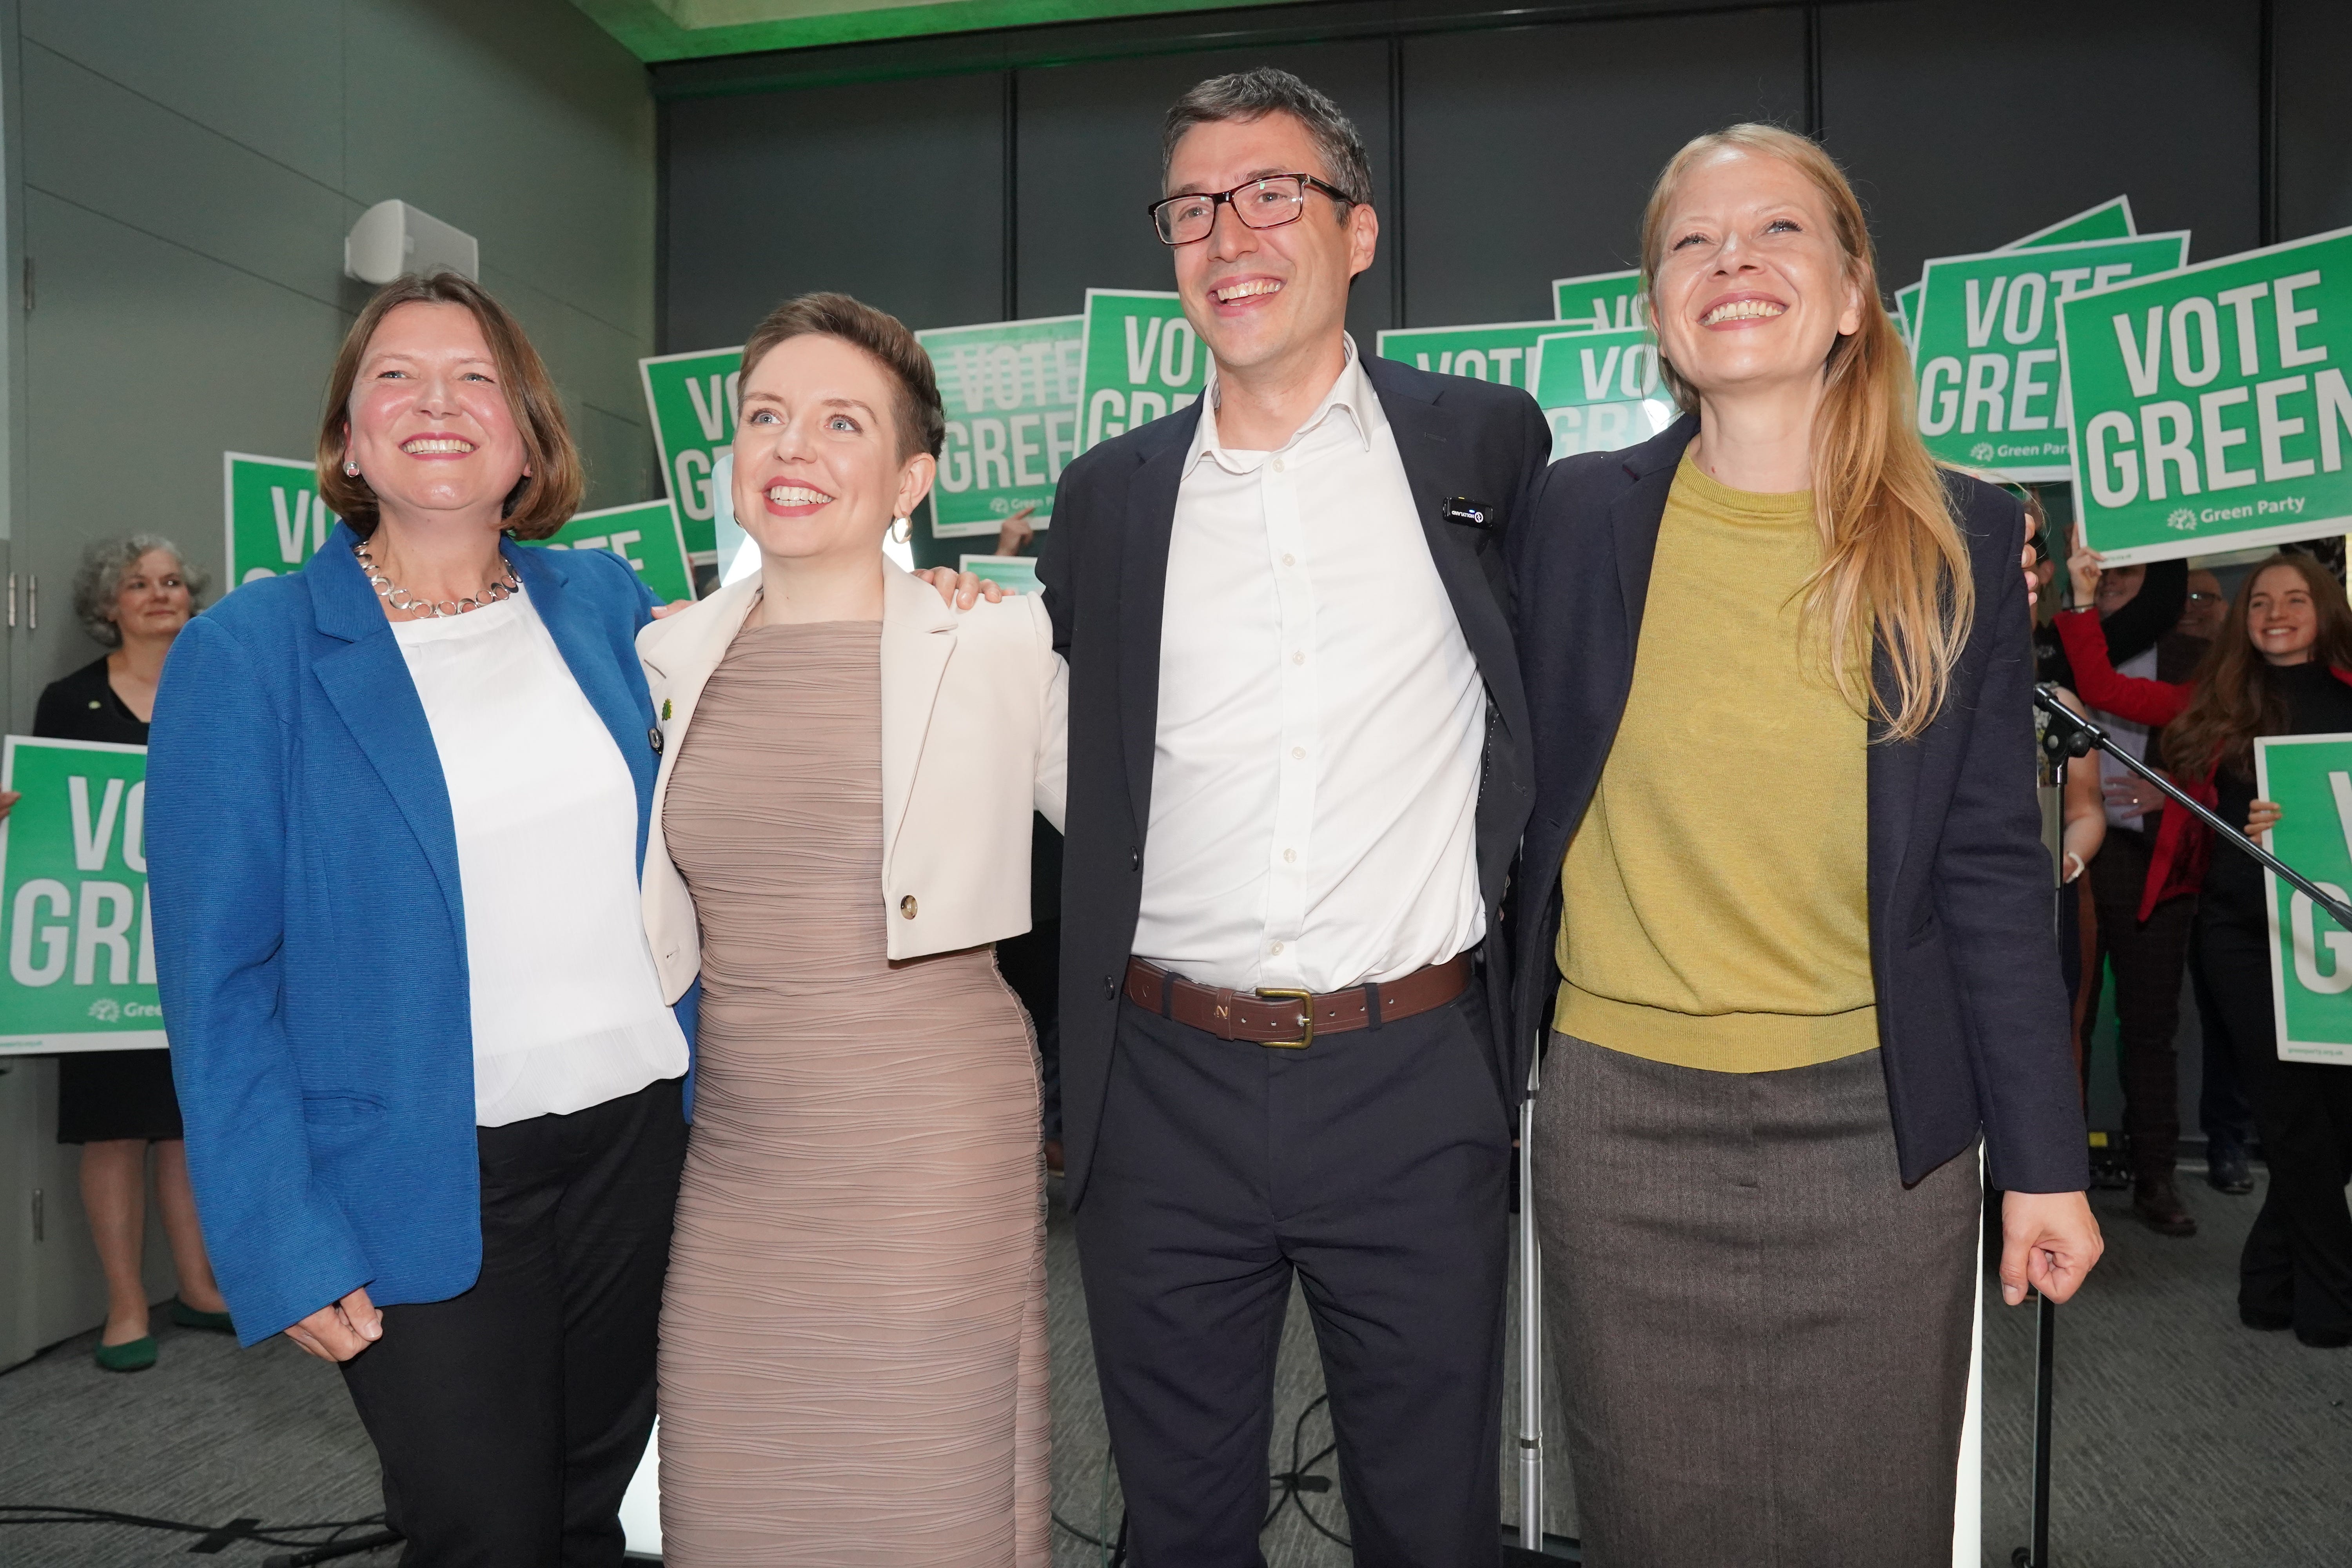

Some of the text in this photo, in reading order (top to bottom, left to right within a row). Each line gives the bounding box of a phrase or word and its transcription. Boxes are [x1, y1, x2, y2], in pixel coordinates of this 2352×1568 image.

[2112, 270, 2327, 397] VOTE
[954, 339, 1082, 413] VOTE
[1998, 444, 2039, 457] Green
[2086, 368, 2352, 508] GREEN
[1451, 510, 1474, 519] HOLLYLAND
[2200, 496, 2305, 523] Green Party
